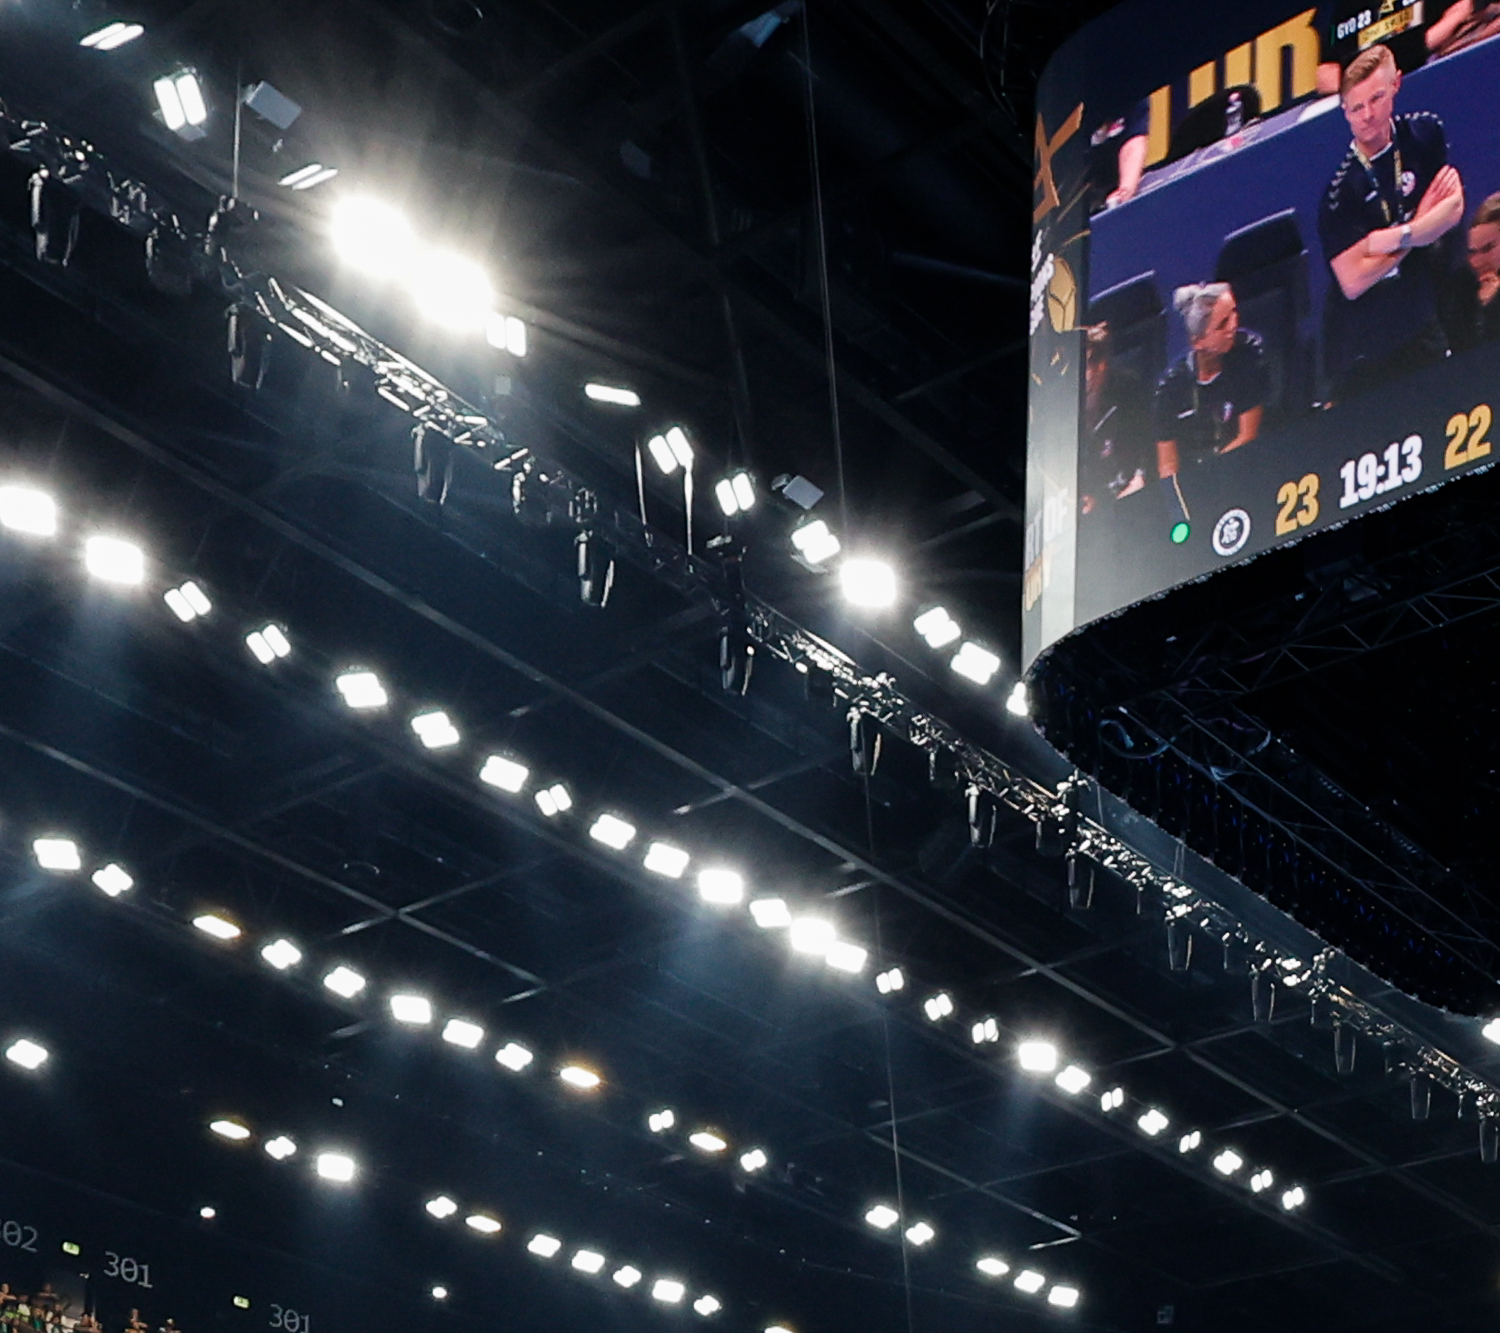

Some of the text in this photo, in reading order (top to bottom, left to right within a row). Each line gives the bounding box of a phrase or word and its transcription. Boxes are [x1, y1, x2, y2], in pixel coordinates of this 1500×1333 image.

[1275, 405, 1492, 534] 23 19:13 22
[103, 1251, 153, 1288] 301
